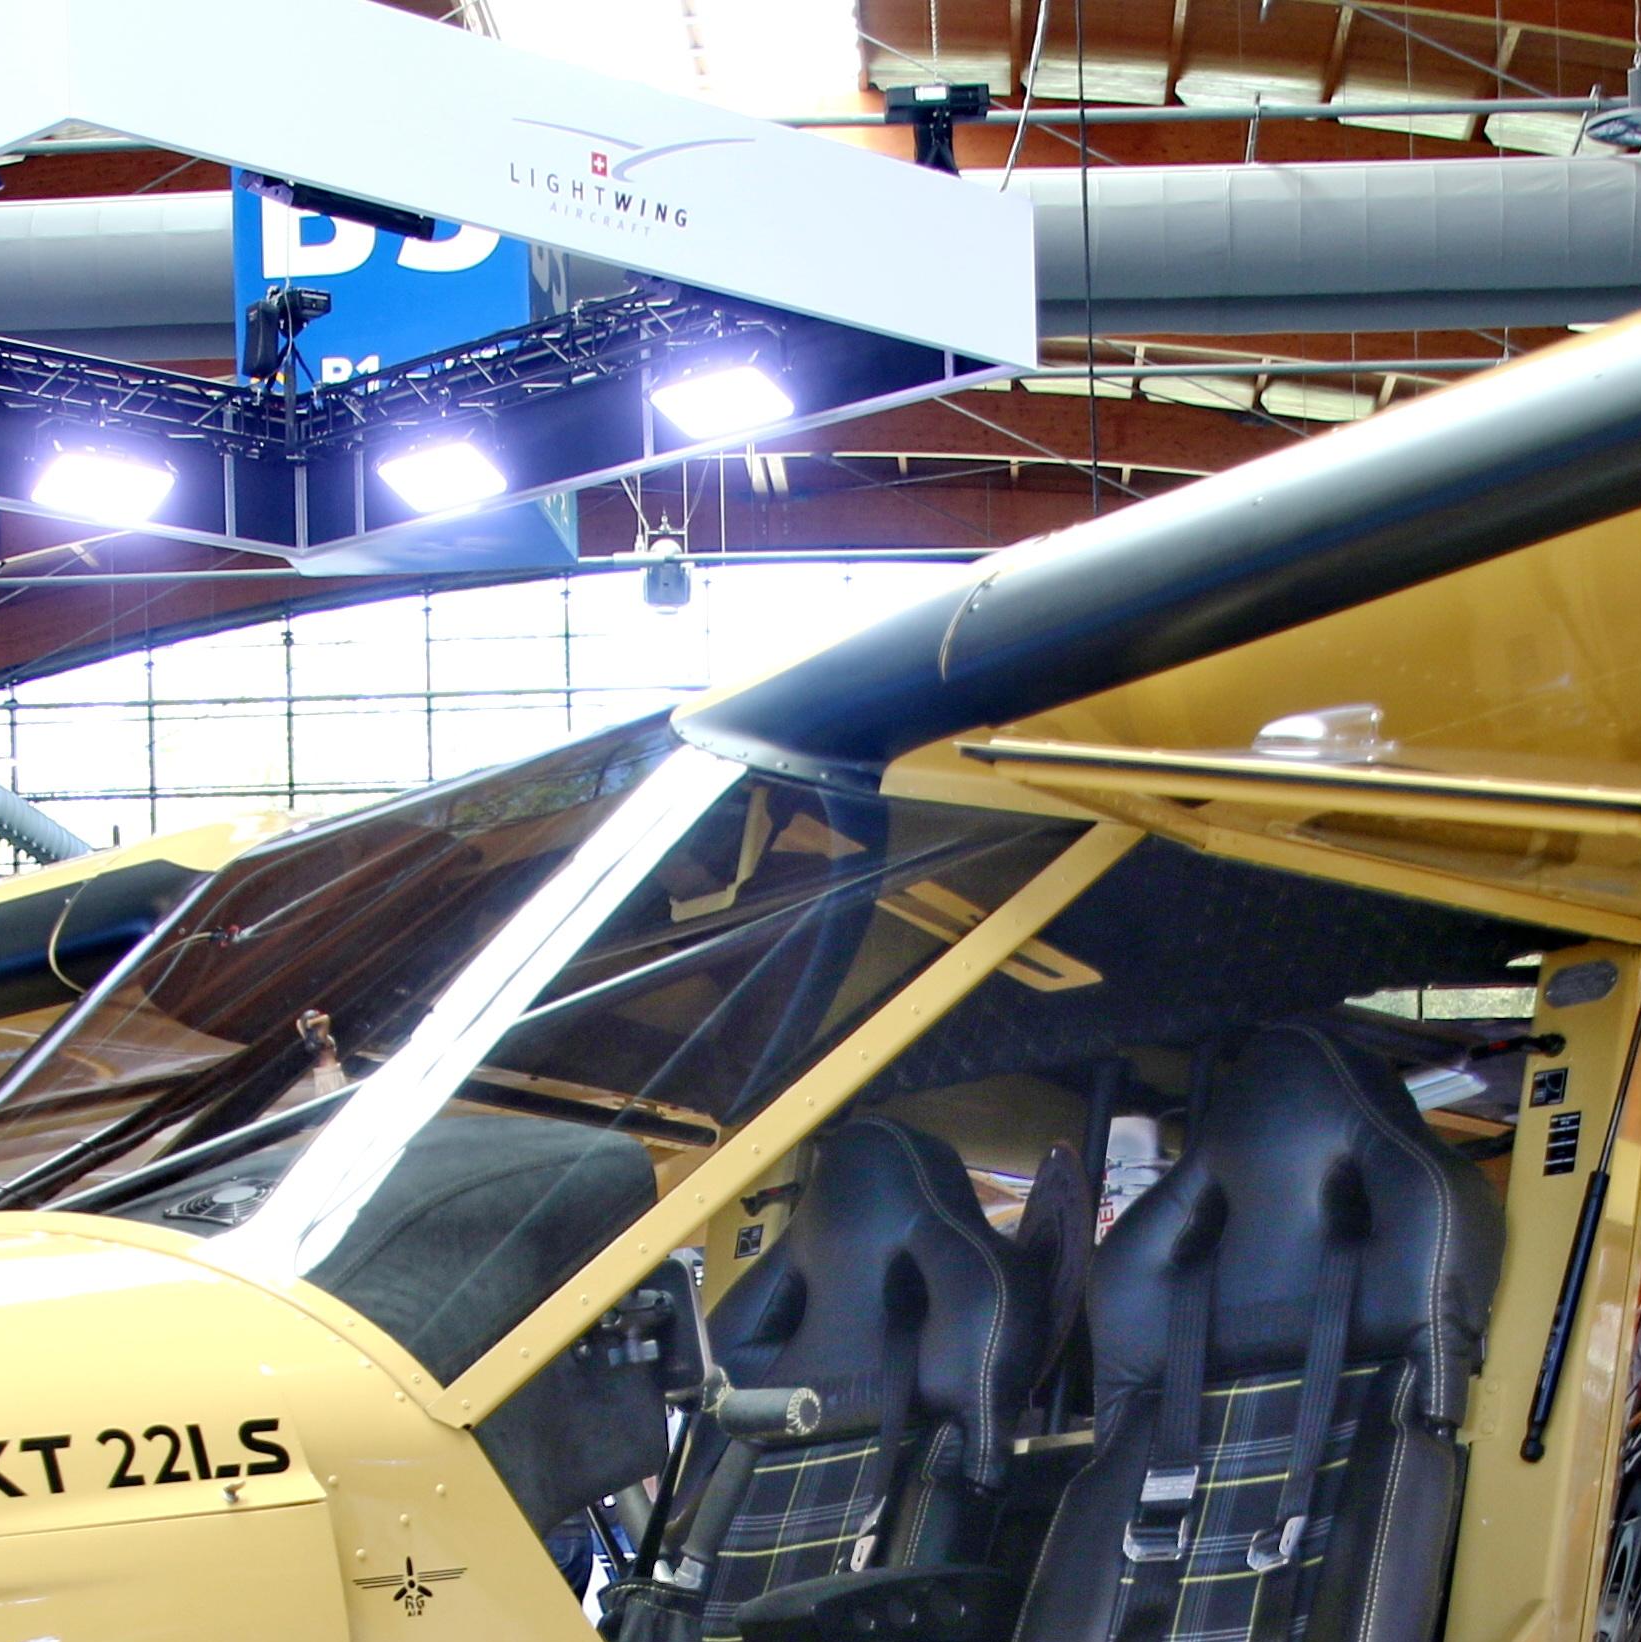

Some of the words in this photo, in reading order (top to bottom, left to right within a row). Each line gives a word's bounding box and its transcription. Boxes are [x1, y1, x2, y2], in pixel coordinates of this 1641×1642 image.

[510, 162, 688, 228] LIGHTWING
[549, 201, 652, 238] AIRCRAFT
[96, 1418, 293, 1490] 22LS
